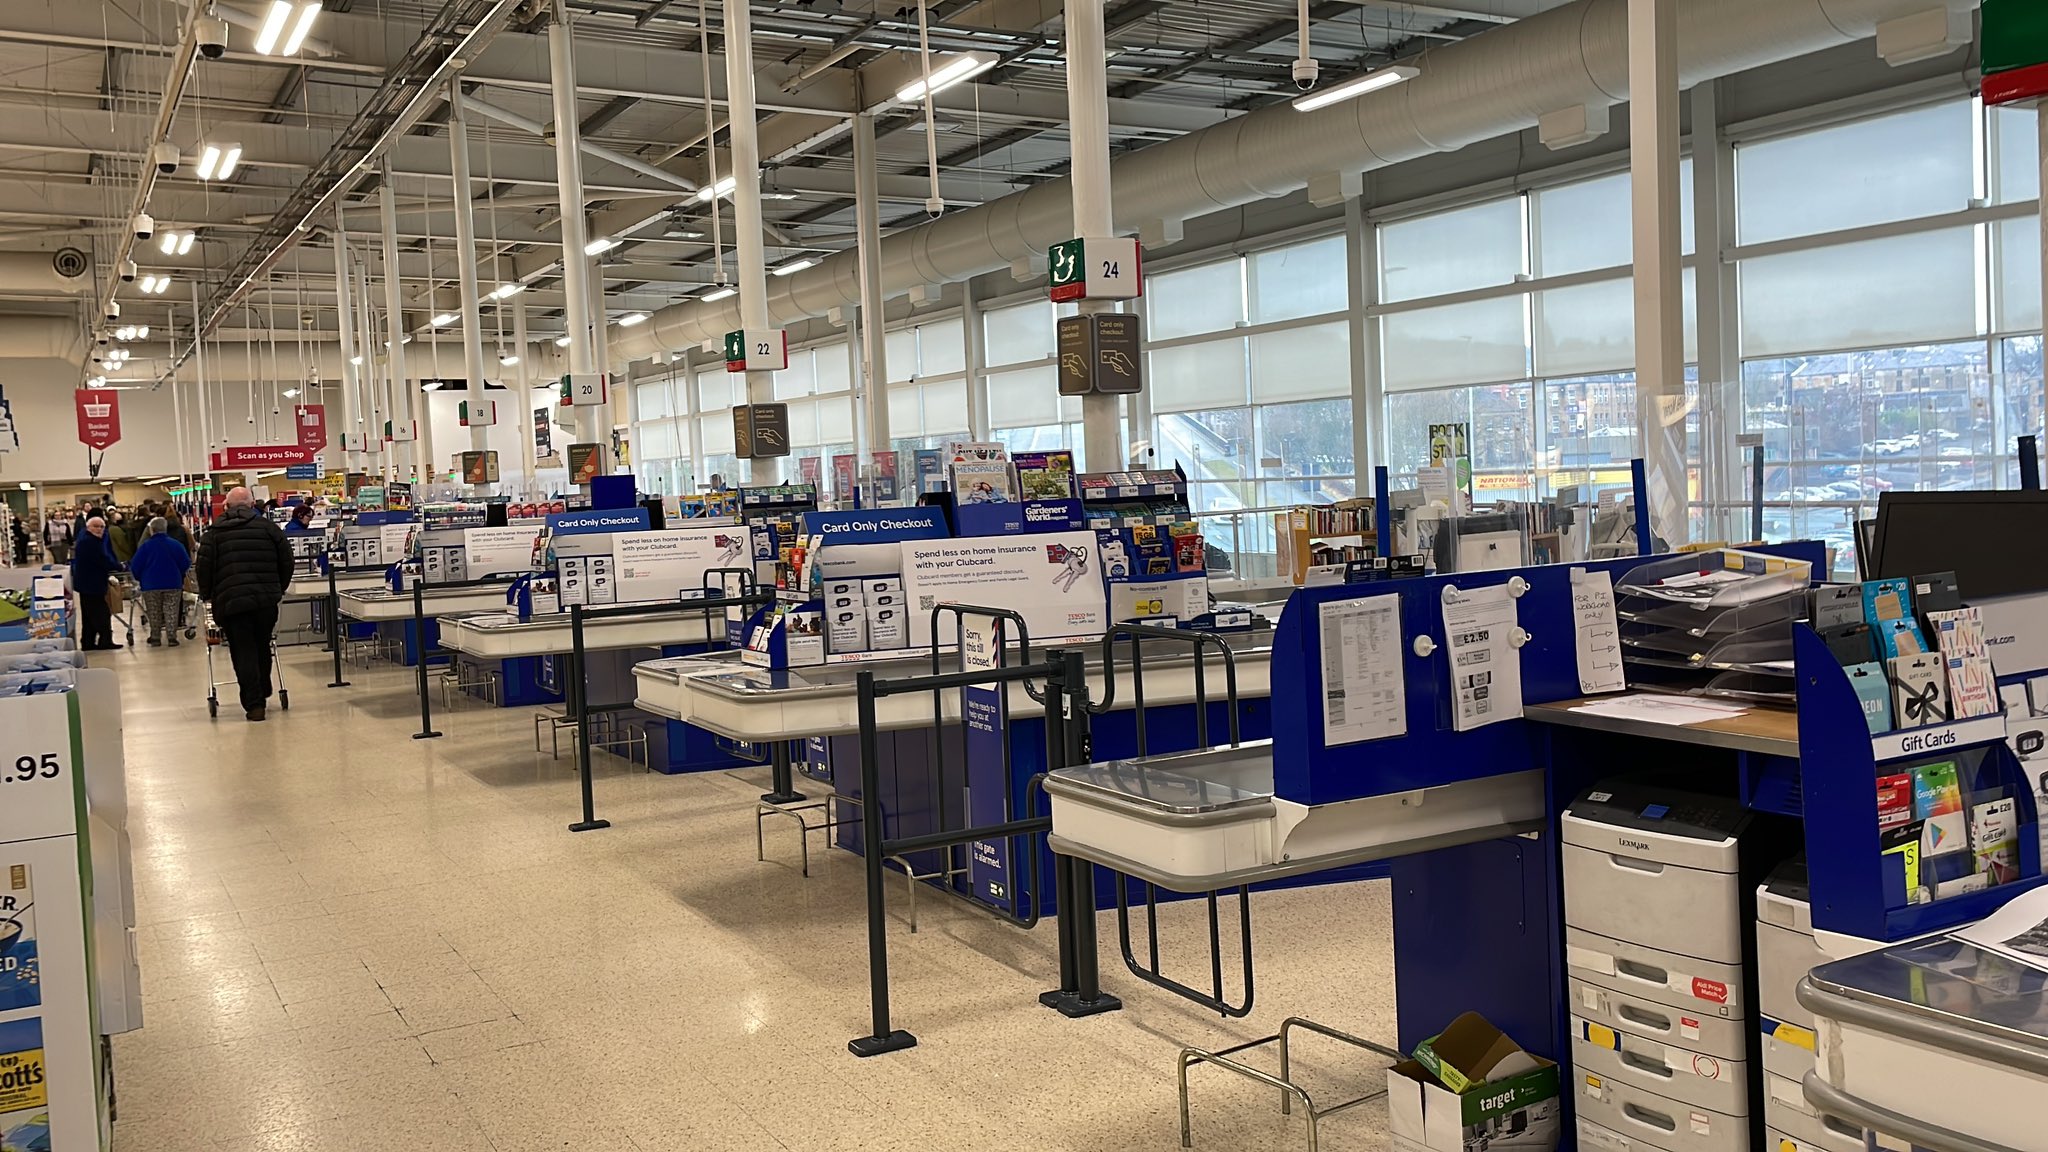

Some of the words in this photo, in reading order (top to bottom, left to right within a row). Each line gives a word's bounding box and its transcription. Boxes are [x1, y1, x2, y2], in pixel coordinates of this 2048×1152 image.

[1103, 261, 1119, 278] 24
[1113, 321, 1124, 329] only
[757, 343, 770, 355] 22
[582, 385, 593, 395] 20
[477, 409, 484, 417] 18
[399, 426, 406, 434] 16
[269, 452, 283, 460] you
[284, 451, 304, 459] Shop
[956, 464, 1005, 474] MENOPAUSE
[1025, 505, 1068, 515] Gardeners'
[558, 519, 578, 529] Card
[579, 518, 600, 528] Only
[600, 515, 640, 526] Checkout
[1026, 513, 1050, 522] World
[822, 521, 850, 533] Card
[852, 520, 878, 533] Only
[880, 517, 934, 530] Checkout
[621, 537, 640, 545] Spend
[662, 535, 679, 543] home
[636, 545, 650, 553] your
[914, 550, 940, 559] Spend
[942, 549, 959, 557] less
[972, 547, 996, 556] home
[997, 544, 1037, 554] insurance
[916, 560, 934, 569] with
[936, 560, 954, 570] your
[956, 557, 996, 568] Clubcard.
[1574, 594, 1589, 602] FOR
[1576, 602, 1611, 611] WORKLOAD
[1068, 612, 1086, 620] TESCO
[1584, 612, 1604, 620] ONLY
[965, 628, 982, 643] Sorry,
[1463, 631, 1489, 644] £2.50
[966, 642, 977, 652] this
[966, 654, 972, 665] is
[972, 655, 991, 667] closed.
[1920, 671, 1933, 679] CARD
[1961, 693, 1987, 702] BIRTHDAY
[1861, 698, 1883, 713] EON
[1902, 734, 1923, 752] Gift
[1925, 730, 1956, 749] Cards
[0, 753, 60, 785] .95
[1917, 787, 1936, 799] Google
[1982, 833, 1994, 842] Gift
[1994, 828, 2007, 839] card
[1619, 837, 1650, 850] LEXMARK
[984, 844, 995, 855] gate
[979, 852, 1001, 868] alarmed.
[1696, 981, 1708, 989] Aldi
[1708, 984, 1723, 993] Price
[1701, 988, 1719, 997] Match
[0, 1061, 44, 1089] ott's
[1480, 1088, 1517, 1112] target
